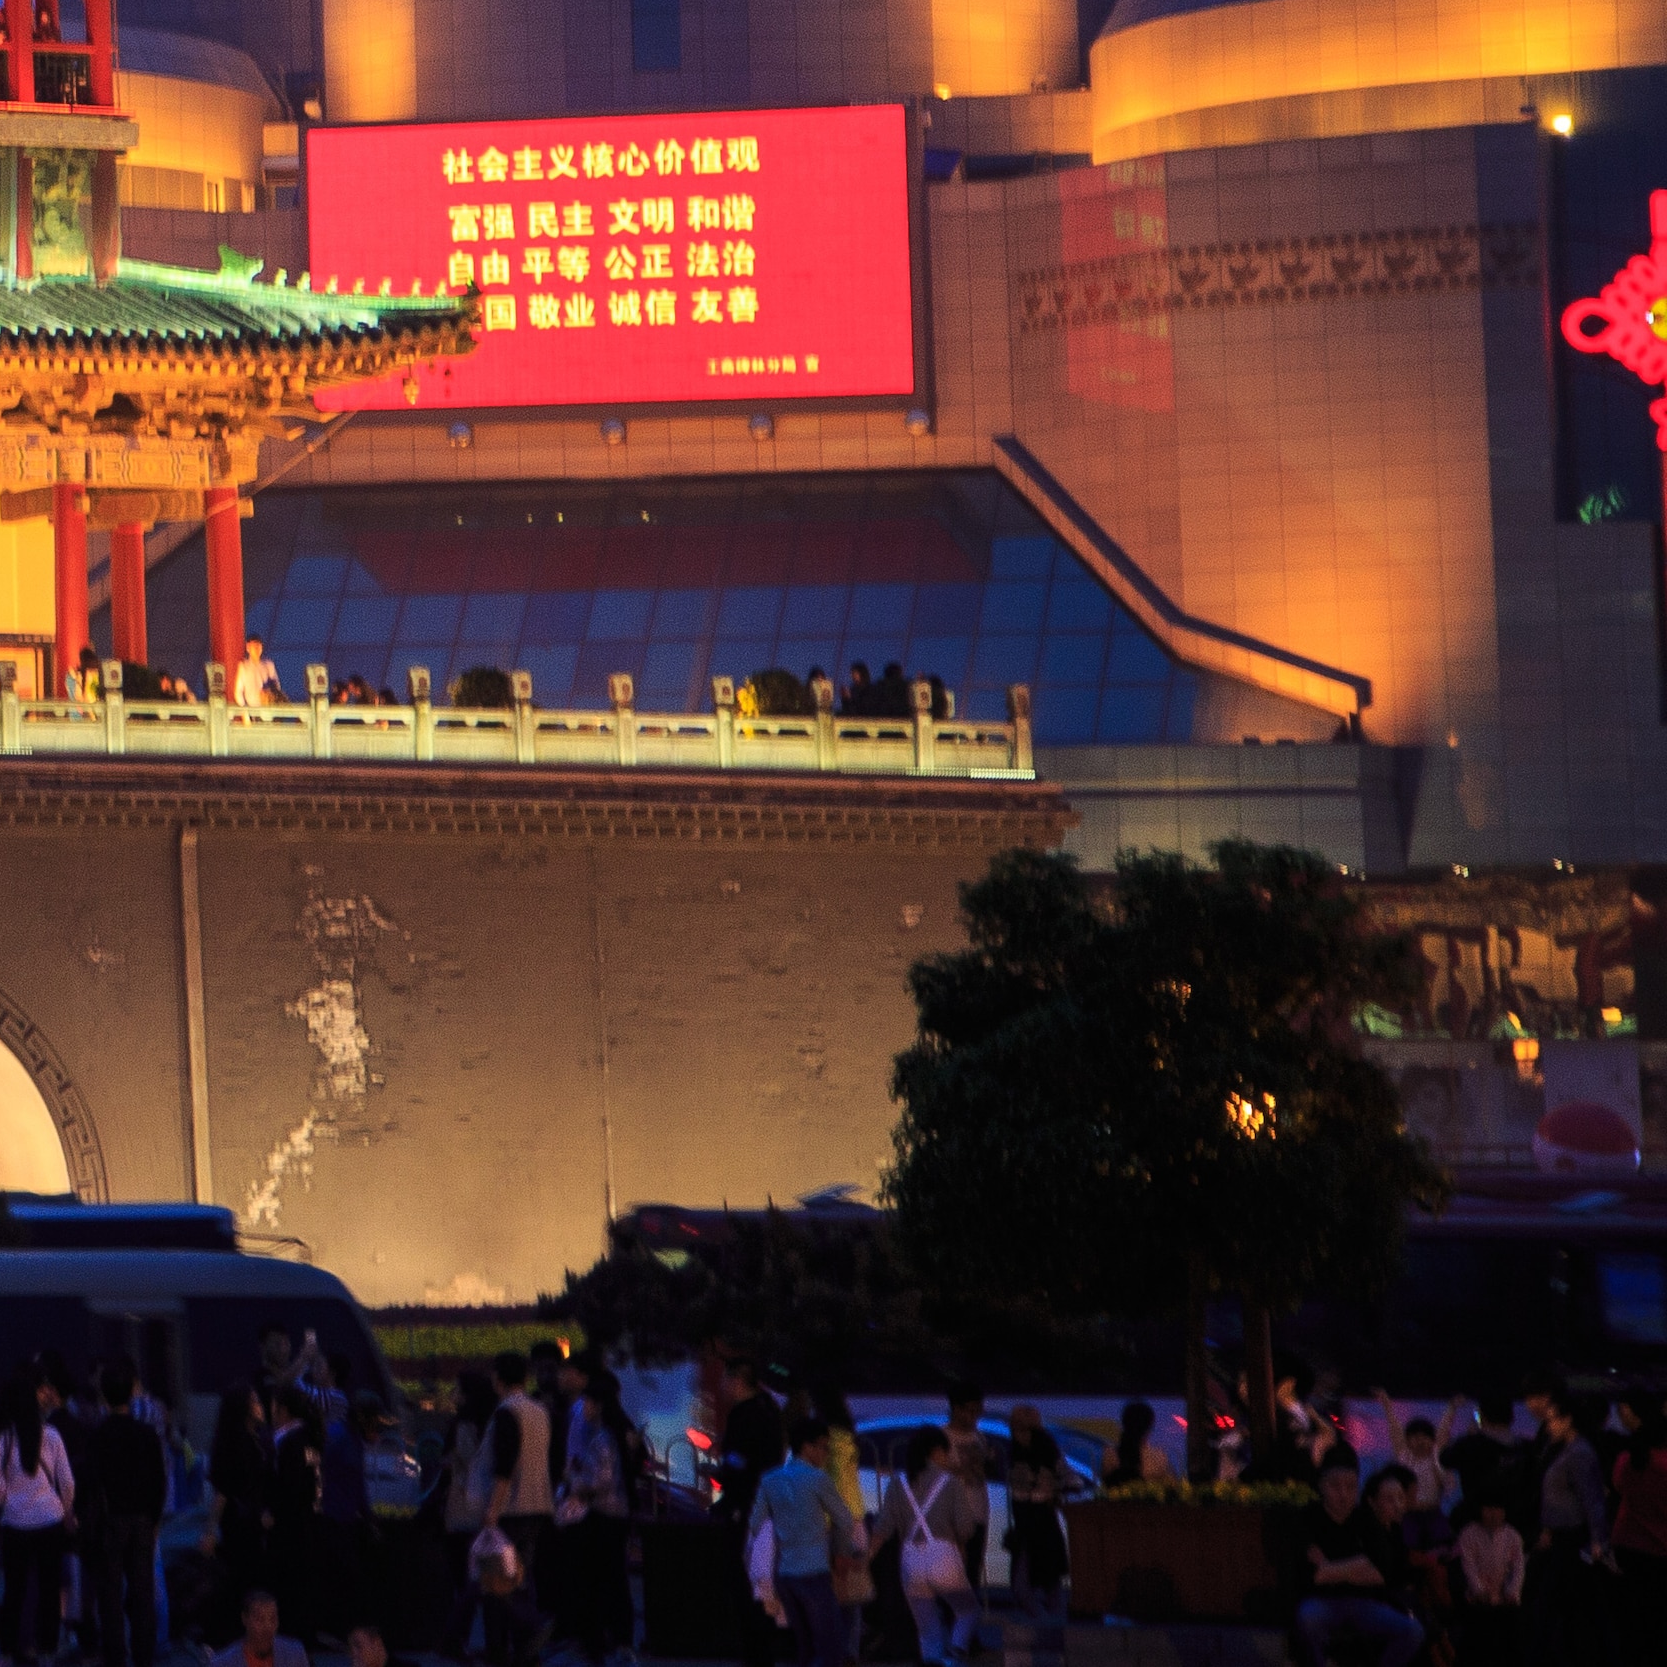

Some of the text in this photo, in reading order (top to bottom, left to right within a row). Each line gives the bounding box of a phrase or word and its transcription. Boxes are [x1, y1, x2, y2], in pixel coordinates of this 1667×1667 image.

[443, 137, 760, 184] 社会主义核心价值观
[448, 193, 755, 242] 富强 民主 文明 和谐
[448, 239, 755, 287] 自由 平等 公正 法治
[475, 286, 759, 331] 国 敬业 诚信 友善
